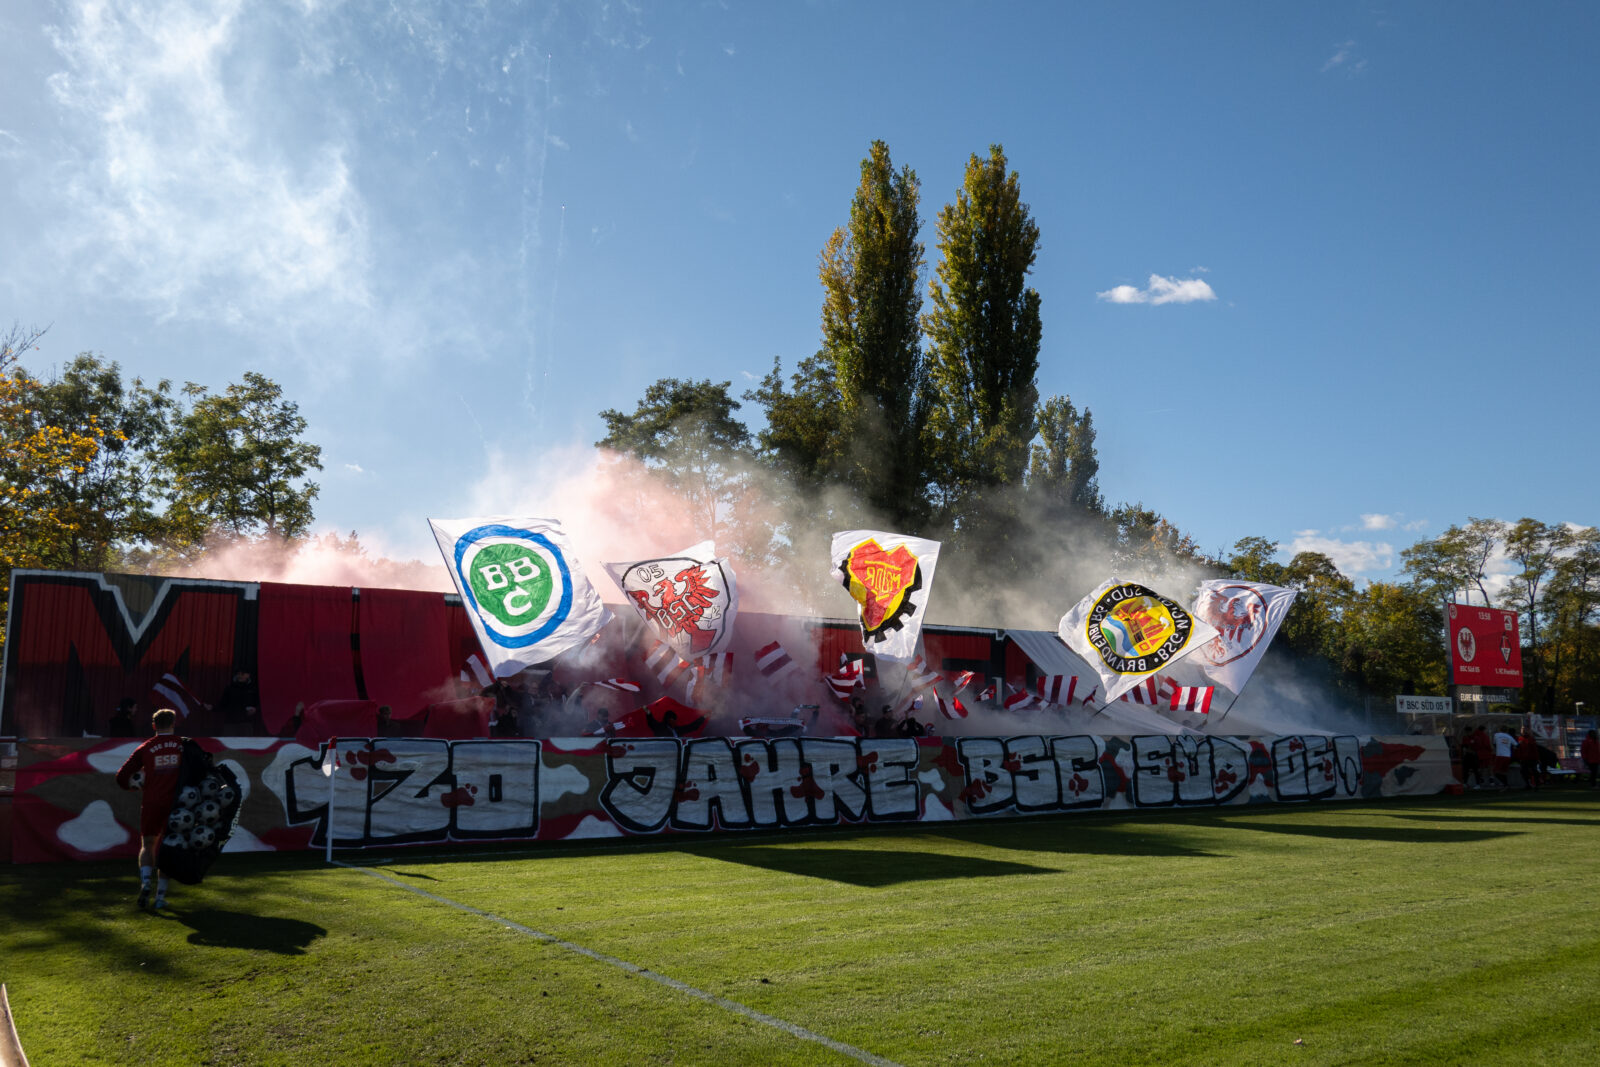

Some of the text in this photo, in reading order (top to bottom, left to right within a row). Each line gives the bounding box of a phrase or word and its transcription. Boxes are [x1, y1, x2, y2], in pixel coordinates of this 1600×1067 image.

[636, 564, 666, 584] 05
[656, 592, 702, 630] BSC
[1406, 699, 1444, 711] BSC SÜD 05
[155, 754, 178, 768] ESB
[286, 738, 541, 849] 120
[601, 737, 921, 833] JAHRE
[957, 735, 1103, 815] BSC
